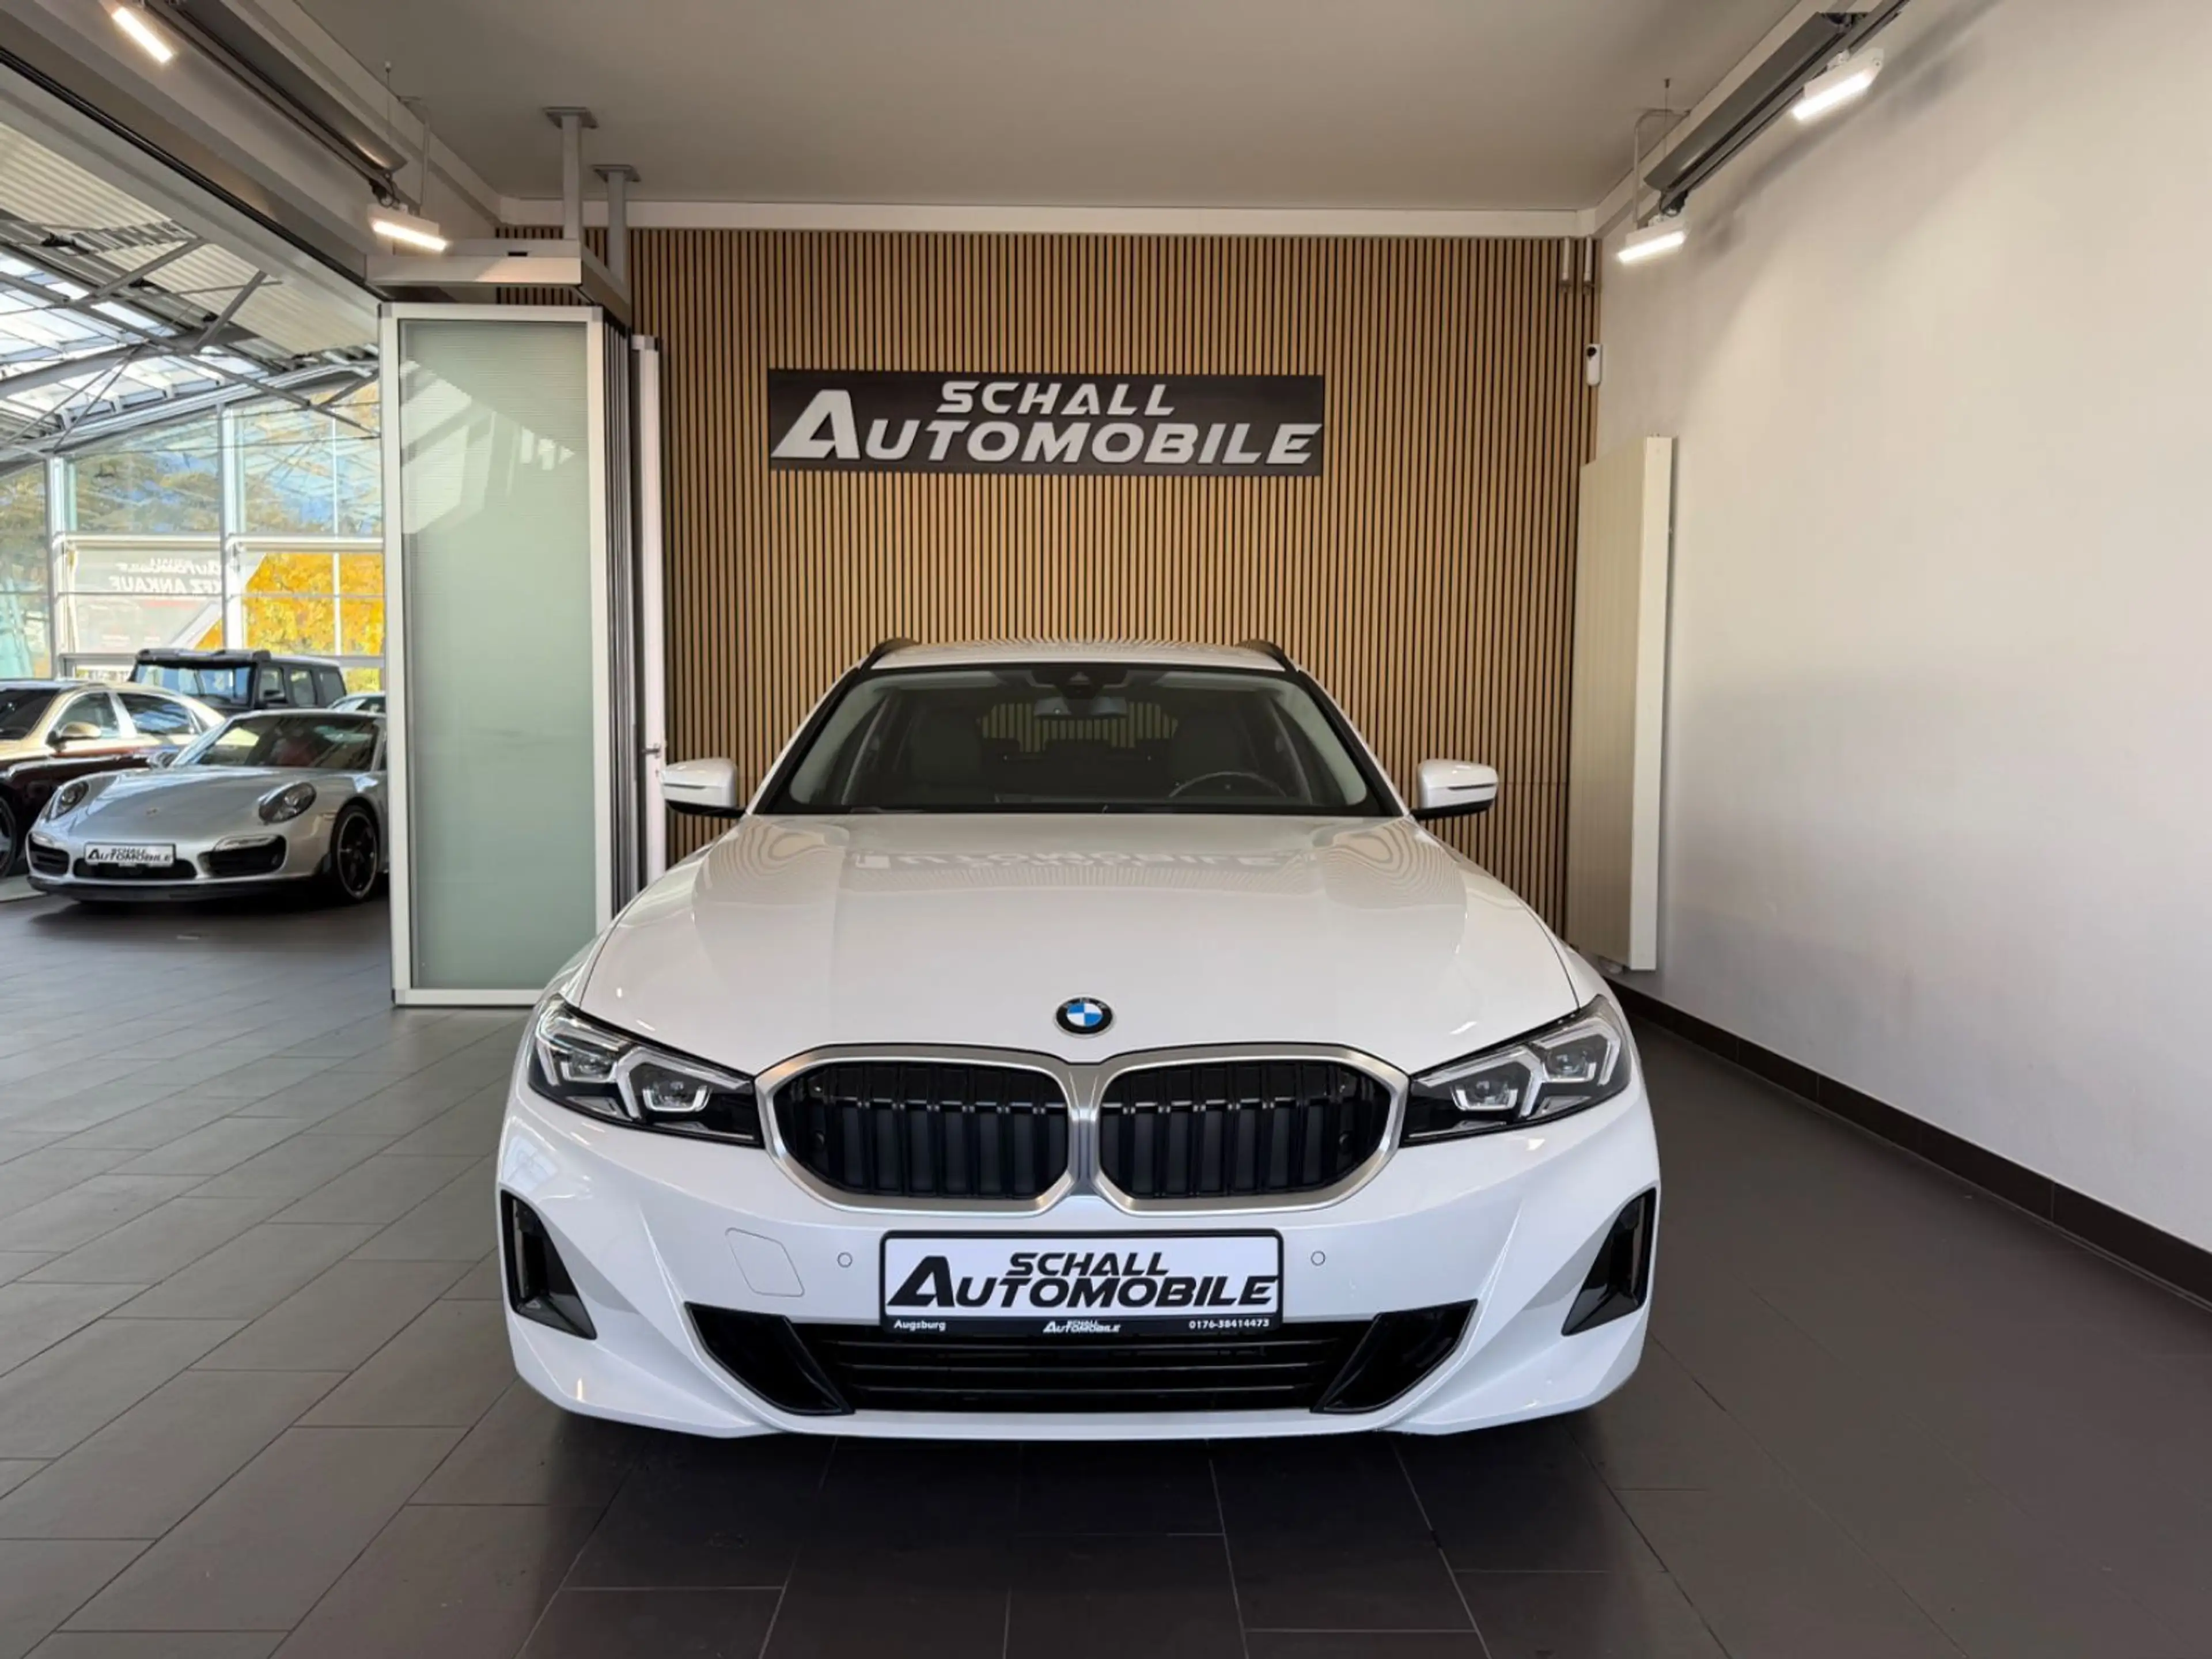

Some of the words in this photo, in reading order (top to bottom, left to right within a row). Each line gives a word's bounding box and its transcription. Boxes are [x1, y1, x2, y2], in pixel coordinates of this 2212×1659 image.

[936, 381, 1175, 416] SCHALL
[771, 389, 1323, 465] AUTOMOBILE
[1005, 1252, 1169, 1277] SCHALL
[887, 1256, 1279, 1308] AUTOMOBILE
[893, 1319, 946, 1332] Augsburg
[1188, 1318, 1270, 1330] 0176-38414473
